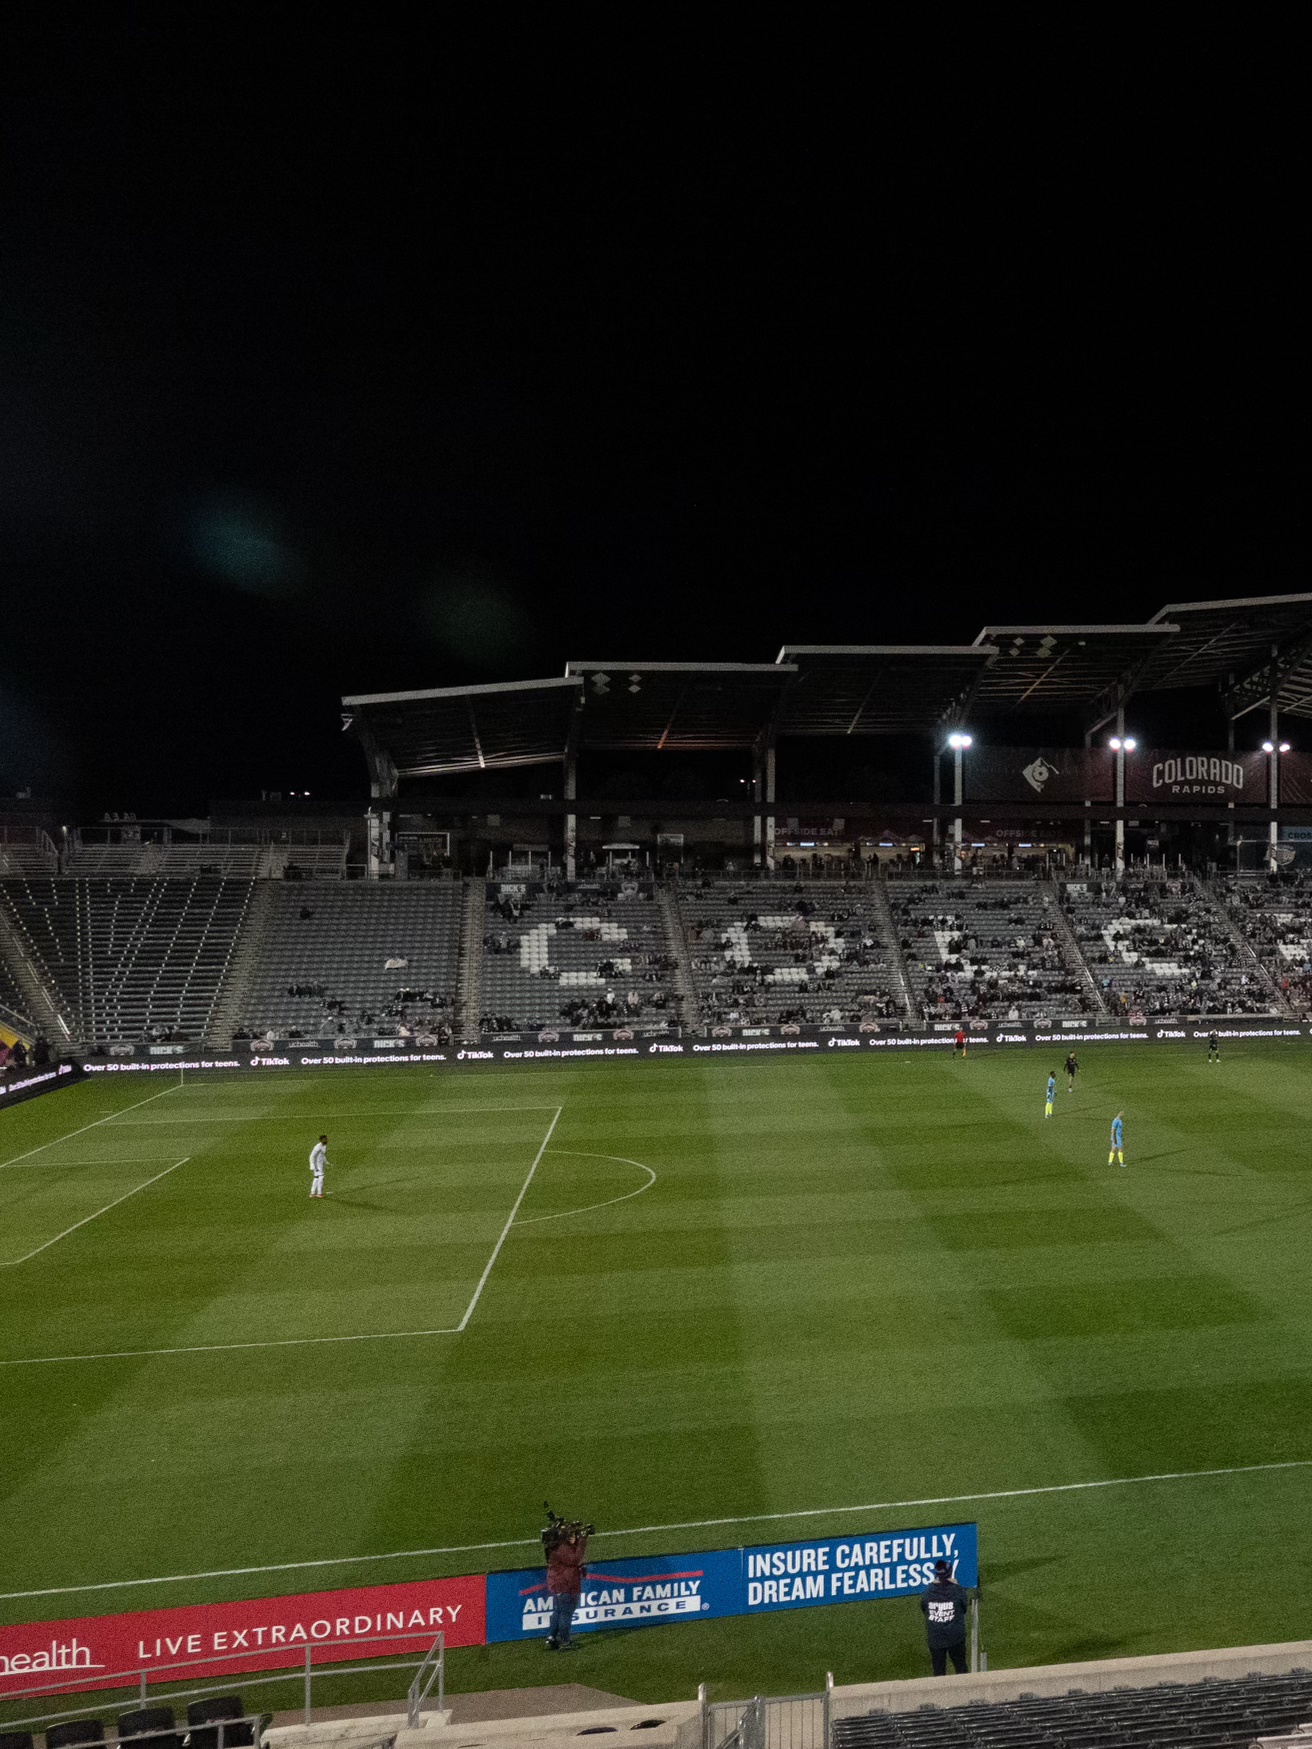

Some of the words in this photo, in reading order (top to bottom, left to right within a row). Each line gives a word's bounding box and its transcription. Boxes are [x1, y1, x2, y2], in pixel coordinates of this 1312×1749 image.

[1153, 756, 1244, 789] COLORADO
[1172, 785, 1225, 794] RAPIDS
[1005, 1034, 1026, 1042] TikTok
[1052, 1034, 1061, 1042] 50
[1084, 1032, 1119, 1042] protections
[1219, 1030, 1239, 1038] built-in
[1240, 1030, 1273, 1038] protections
[712, 1044, 721, 1052] 50
[722, 1042, 746, 1050] built-in
[747, 1042, 786, 1050] protections
[837, 1038, 860, 1046] TikTok
[897, 1038, 919, 1046] built-in
[504, 1050, 523, 1058] Over
[535, 1050, 561, 1058] built-in
[562, 1048, 604, 1058] protections
[658, 1044, 683, 1052] TikTok
[302, 1056, 322, 1064] Over
[323, 1056, 334, 1064] 50
[335, 1056, 362, 1064] built-in
[363, 1054, 409, 1064] protections
[468, 1050, 493, 1060] TikTok
[84, 1064, 106, 1072] Over
[107, 1064, 119, 1072] 50
[120, 1062, 150, 1070] built-in
[151, 1060, 200, 1071] protections
[262, 1058, 289, 1066] TikTok
[748, 1547, 830, 1578] INSURE
[836, 1533, 959, 1569] CAREFULLY,
[748, 1575, 825, 1606] DREAM
[831, 1560, 960, 1596] FEARLESSY
[523, 1588, 625, 1614] AMICAN
[632, 1580, 700, 1602] FAMILY
[538, 1601, 687, 1625] ISURANCE
[928, 1614, 955, 1622] STAFF
[139, 1635, 202, 1659] LIVE
[213, 1605, 463, 1651] EXTRAORDINARY
